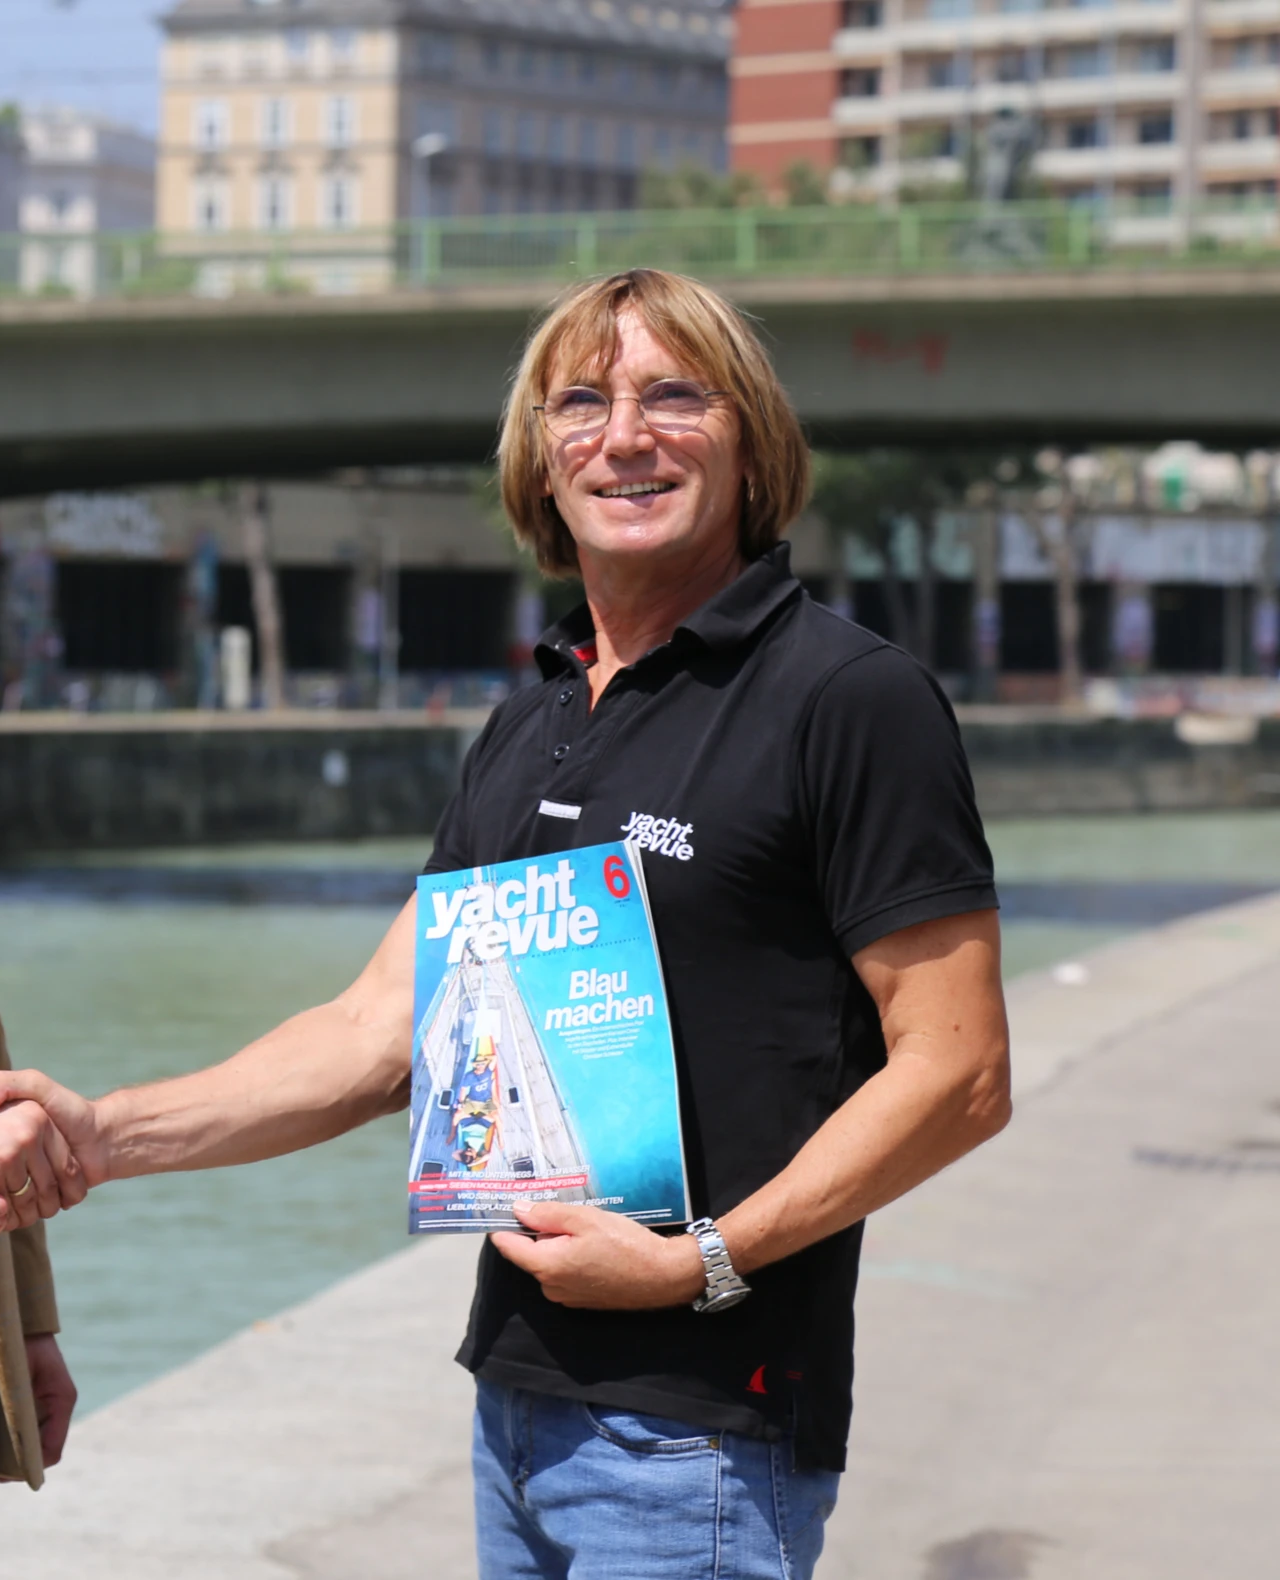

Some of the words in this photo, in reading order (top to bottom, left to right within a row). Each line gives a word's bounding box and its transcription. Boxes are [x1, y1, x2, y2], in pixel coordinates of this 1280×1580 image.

[620, 811, 694, 843] yacht
[623, 827, 694, 861] revue
[603, 855, 631, 899] 6
[425, 859, 575, 939] yacht
[446, 905, 599, 964] revue
[569, 969, 627, 999] Blau
[544, 994, 654, 1030] machen
[448, 1170, 462, 1178] MIT
[485, 1170, 532, 1179] UNTERWEGS
[512, 1182, 527, 1190] AUF
[528, 1180, 545, 1189] DEM
[544, 1177, 585, 1188] PRÜFSTAND
[490, 1192, 508, 1200] UND
[586, 1196, 624, 1206] REGATTEN
